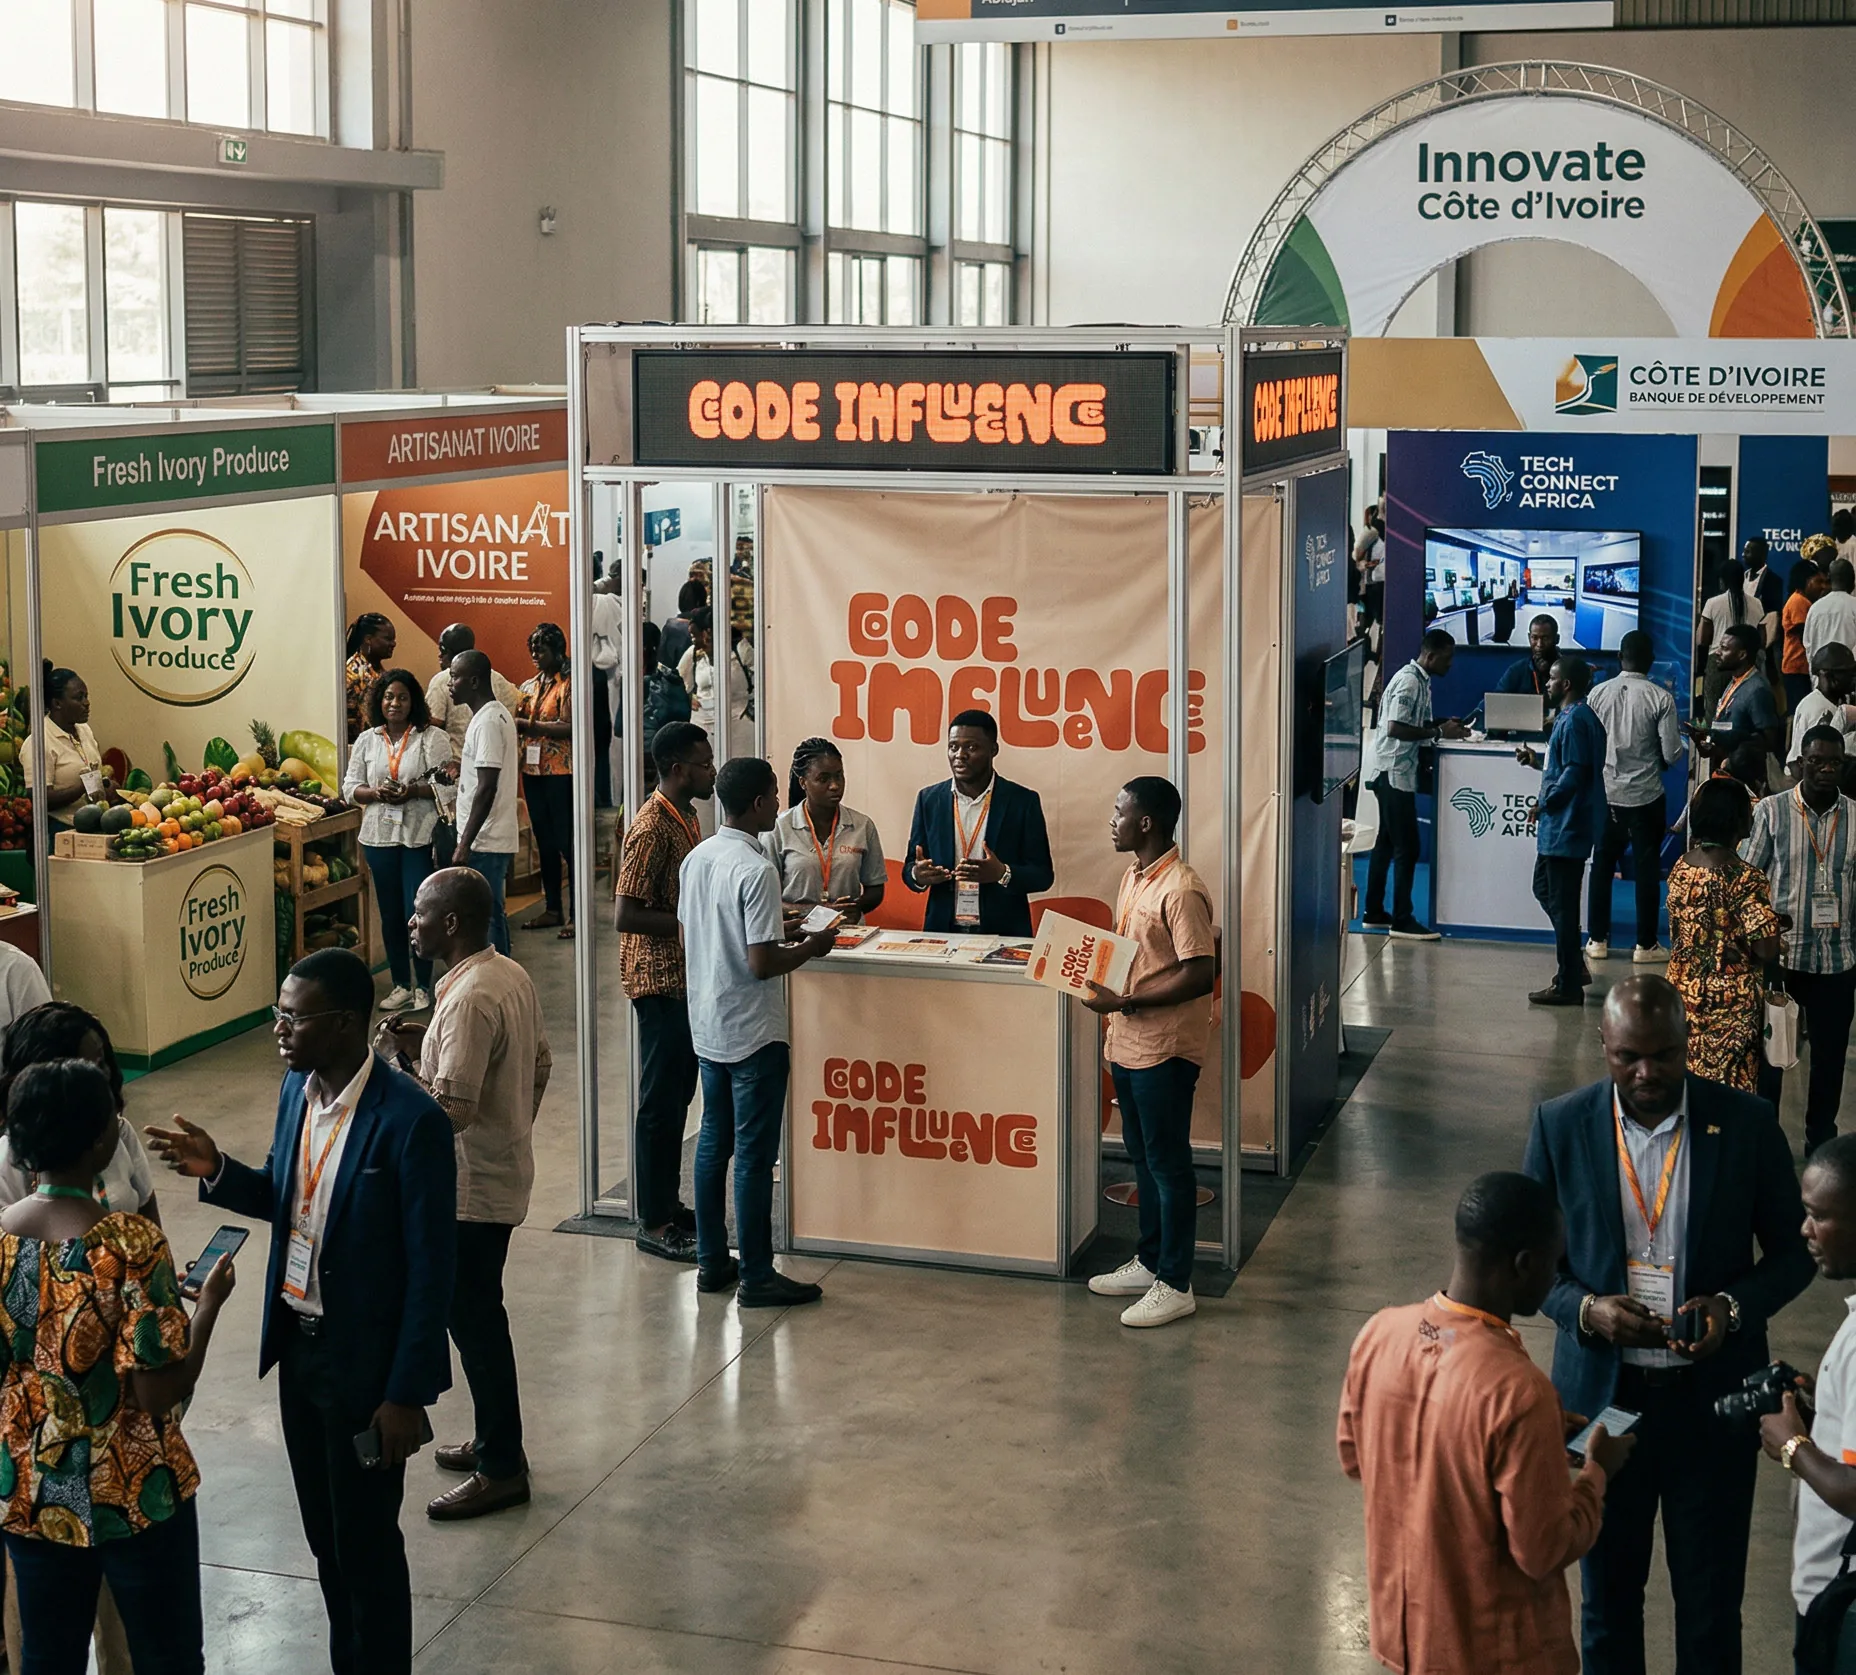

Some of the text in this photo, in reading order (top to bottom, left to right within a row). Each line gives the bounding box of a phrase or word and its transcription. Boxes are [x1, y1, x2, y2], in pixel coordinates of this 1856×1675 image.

[1418, 142, 1646, 183] Innovate
[1418, 190, 1645, 220] Côte d’Ivoire
[1630, 360, 1826, 387] CÔTE D’IVOIRE
[688, 380, 820, 440] CODE
[1253, 380, 1283, 443] CODE
[1629, 391, 1825, 405] BANQUE DE DÉVELOPPEMENT
[388, 423, 541, 464] ARTISANAT IVOIRE
[93, 445, 290, 487] Fresh Ivory Produce
[1520, 456, 1574, 472] TECH
[1520, 474, 1619, 491] CONNECT
[1519, 493, 1595, 509] AFRICA
[373, 501, 570, 547] ARTISANAT
[1762, 528, 1802, 540] TECH
[130, 562, 239, 599] Fresh
[417, 549, 529, 580] IVOIRE
[112, 593, 254, 655] Ivory
[848, 592, 1018, 662] CODE
[131, 645, 236, 671] Produce
[1503, 794, 1538, 807] TEC
[188, 884, 239, 925] Fresh
[180, 915, 246, 961] Ivory
[189, 950, 239, 980] Produce
[1060, 946, 1080, 978] CODE
[824, 1057, 927, 1105] CODE
